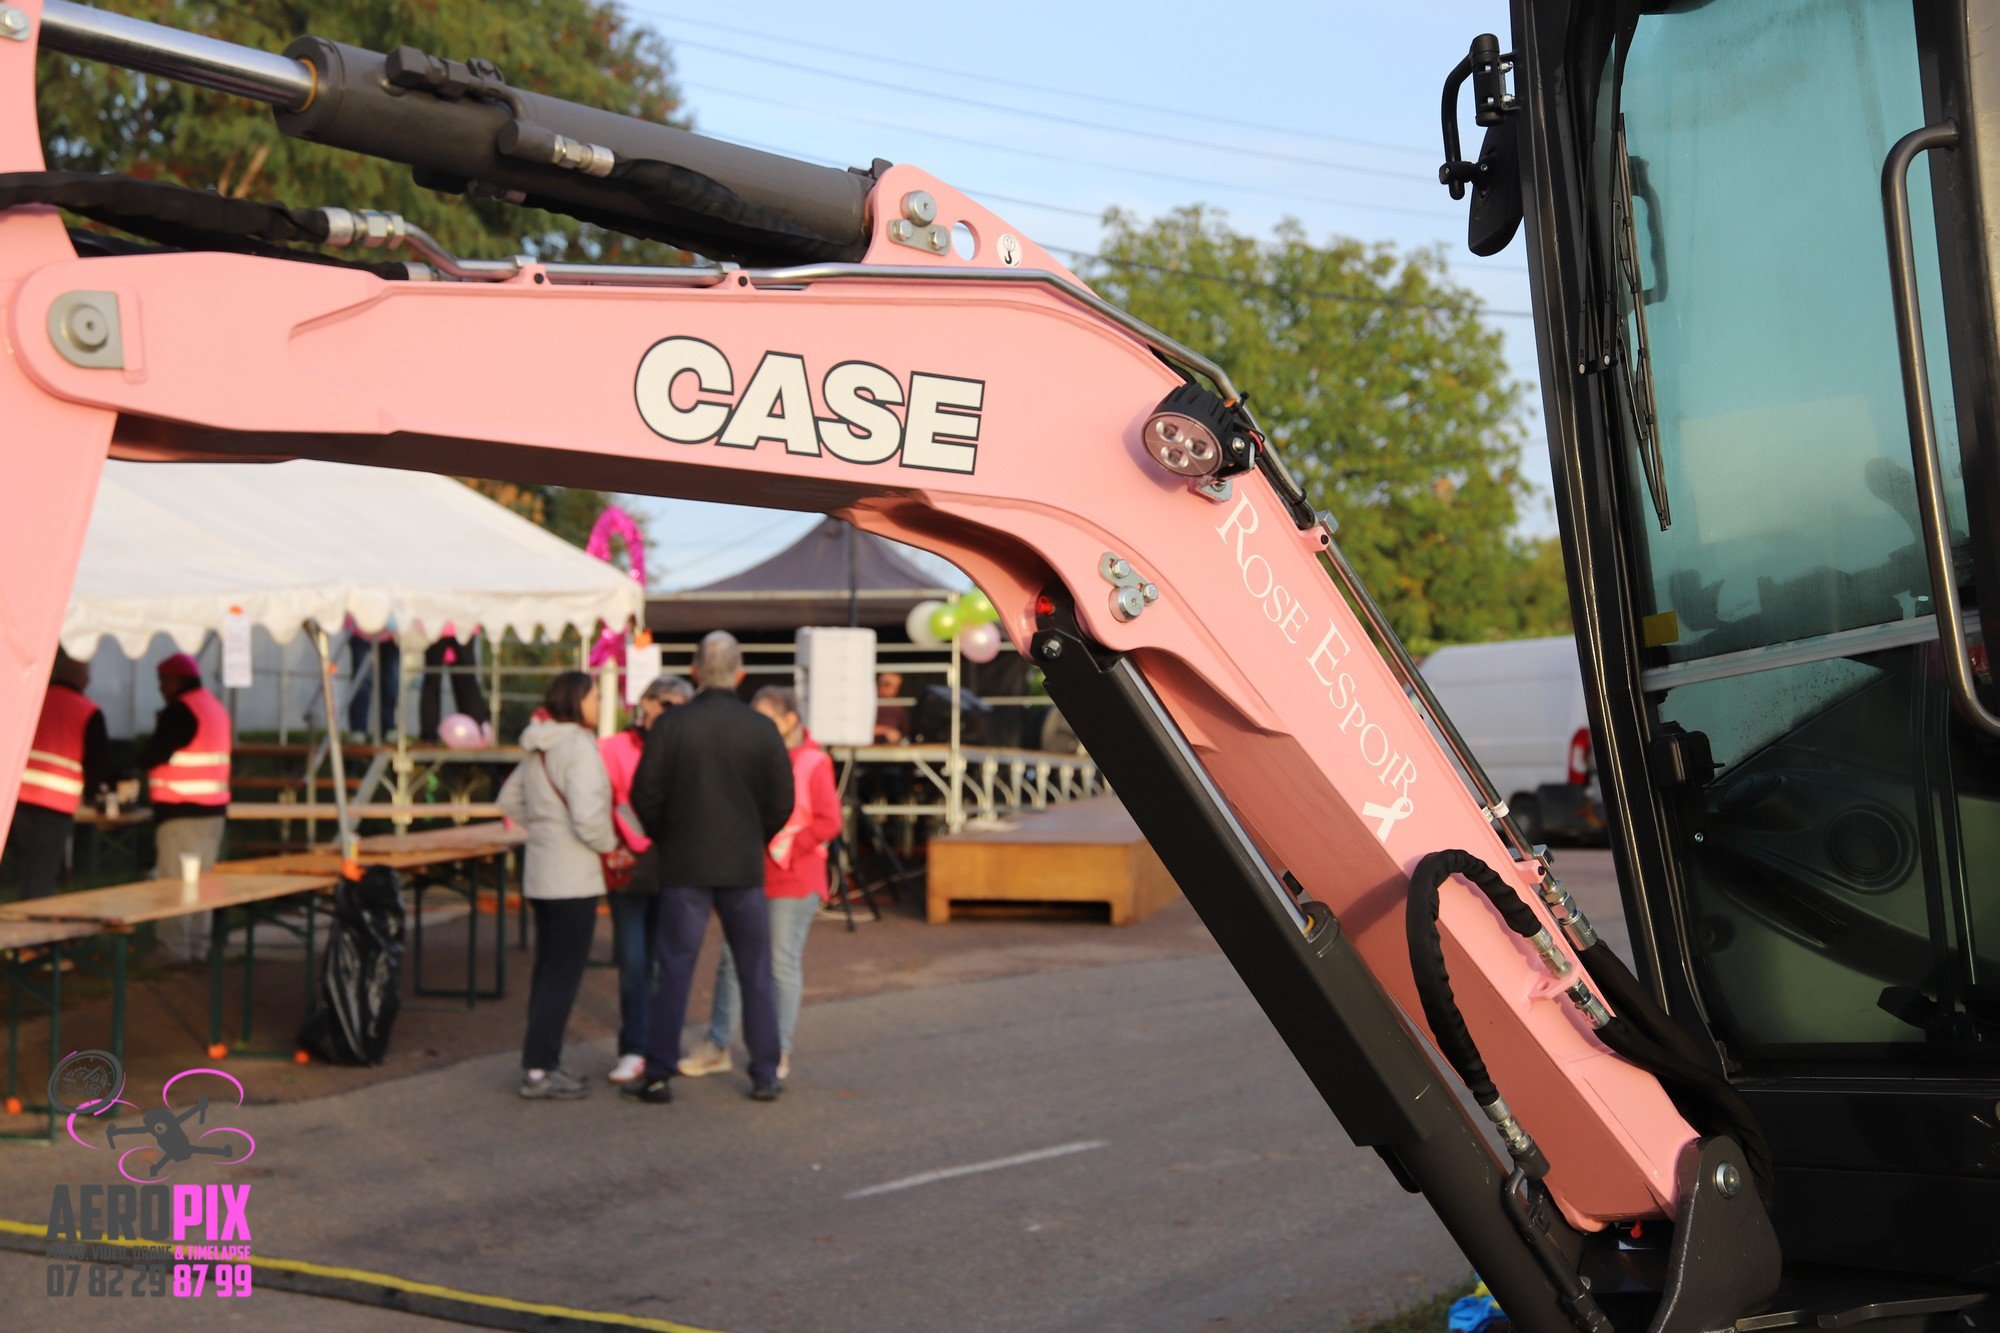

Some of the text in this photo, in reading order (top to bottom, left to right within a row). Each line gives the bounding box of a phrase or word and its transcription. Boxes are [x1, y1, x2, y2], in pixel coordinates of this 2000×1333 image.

[634, 335, 985, 475] CASE
[1215, 489, 1418, 797] ROSE ESPOIR
